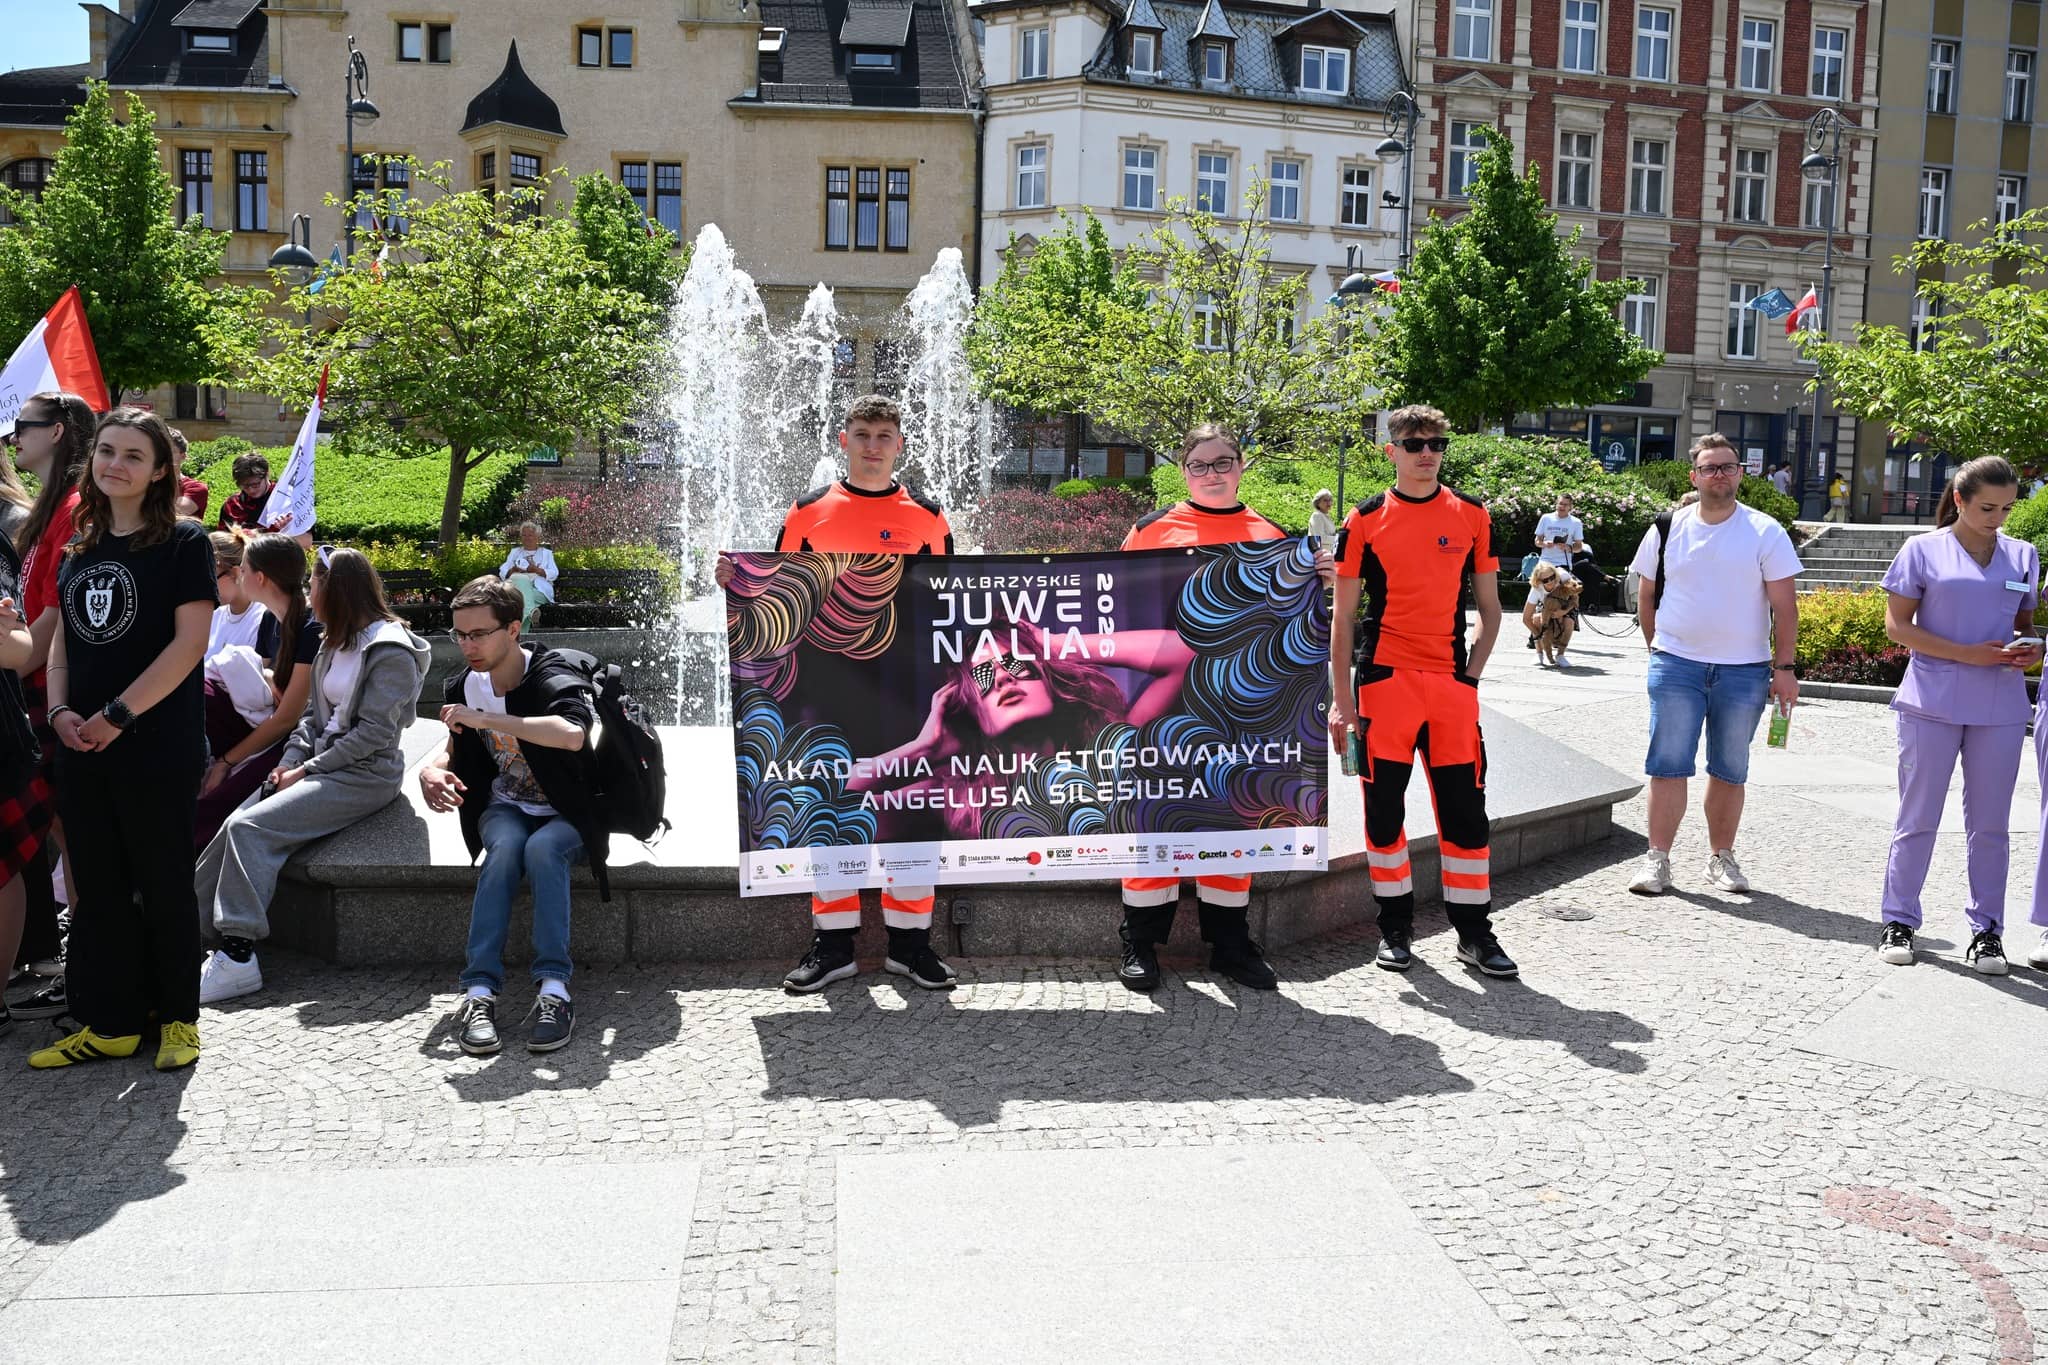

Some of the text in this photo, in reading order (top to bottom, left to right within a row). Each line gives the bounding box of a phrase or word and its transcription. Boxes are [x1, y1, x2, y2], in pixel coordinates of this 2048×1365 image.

[929, 574, 1081, 590] WAŁBRZYSKIE
[932, 589, 1083, 626] JUWE
[1096, 573, 1116, 658] 2026
[932, 626, 1091, 664] NALIA
[763, 742, 1302, 782] AKADEMIA NAUK STOSOWANYCH
[859, 777, 1209, 811] ANGELUSA SILESIUSA
[1198, 850, 1228, 860] Gazeta
